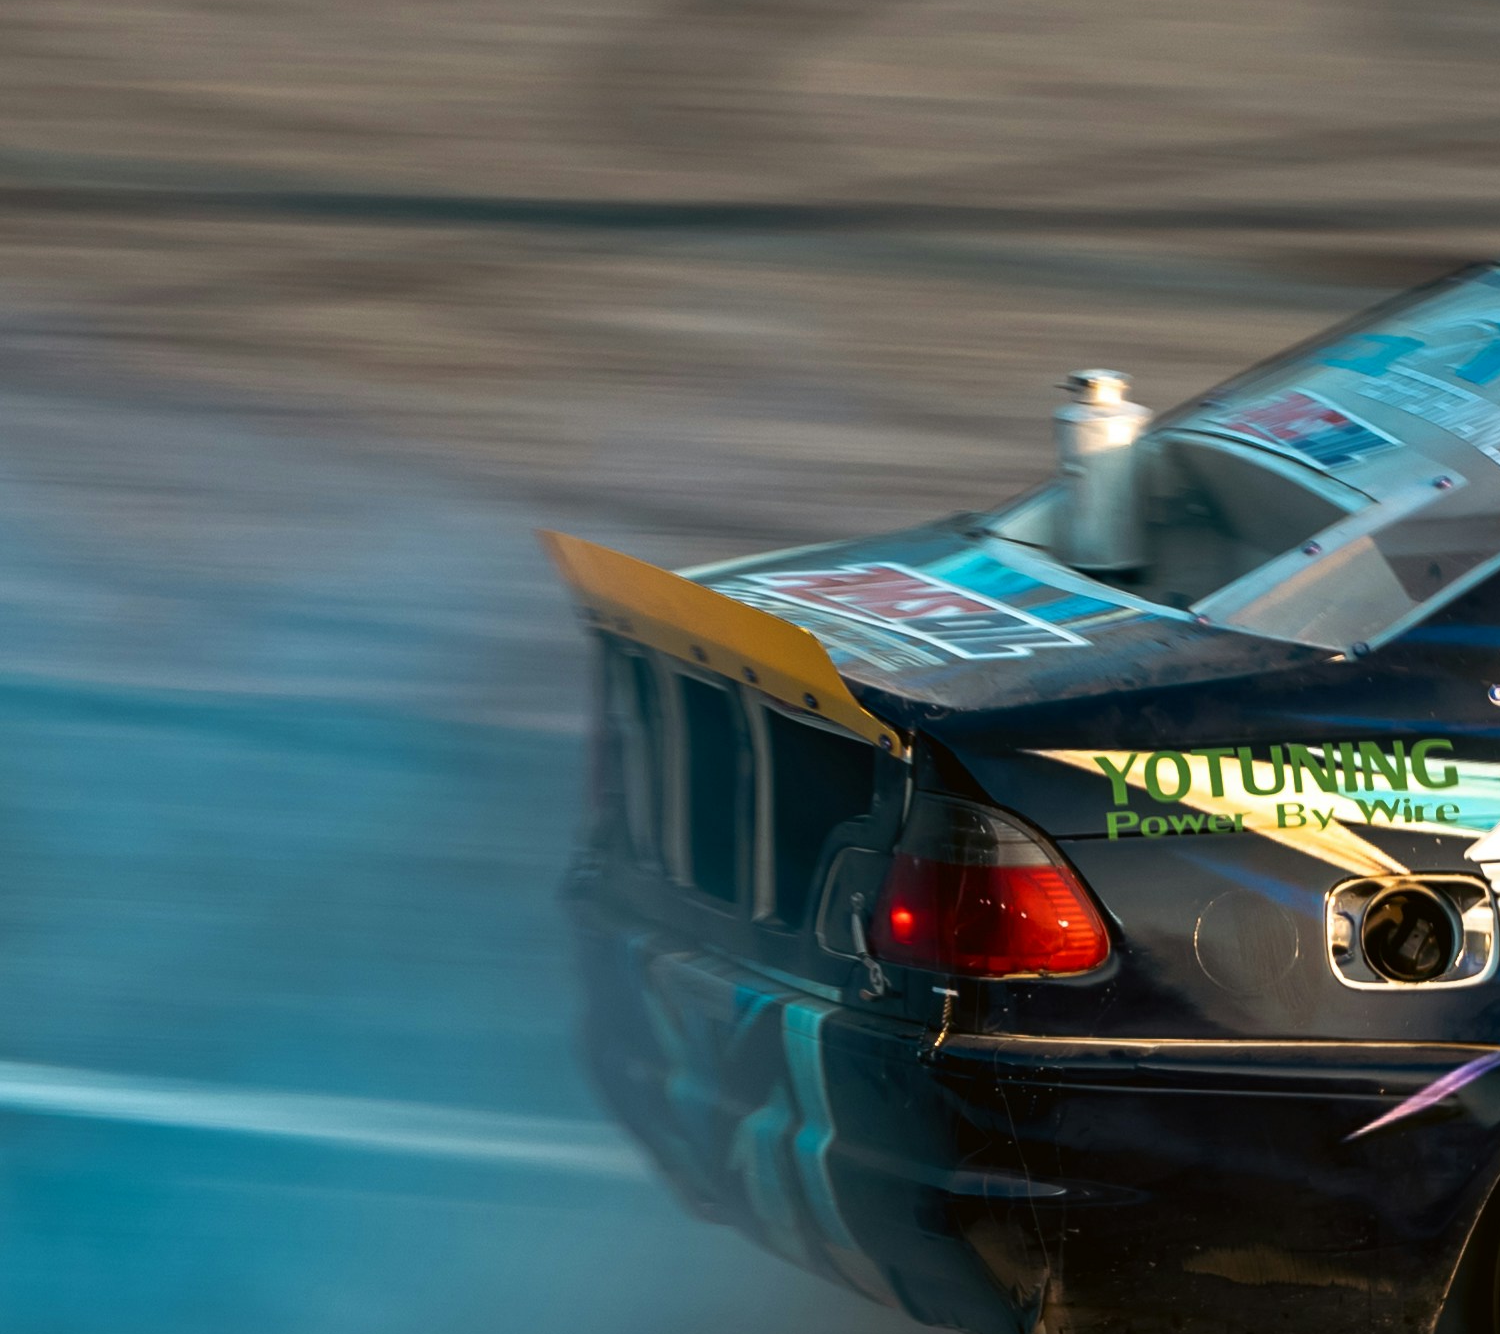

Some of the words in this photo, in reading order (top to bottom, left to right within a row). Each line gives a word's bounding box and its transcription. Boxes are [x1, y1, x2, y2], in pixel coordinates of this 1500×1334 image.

[1093, 738, 1460, 807] YOTUNING
[1105, 810, 1251, 841] Power
[1276, 802, 1336, 831] By
[1355, 797, 1461, 826] Wire
